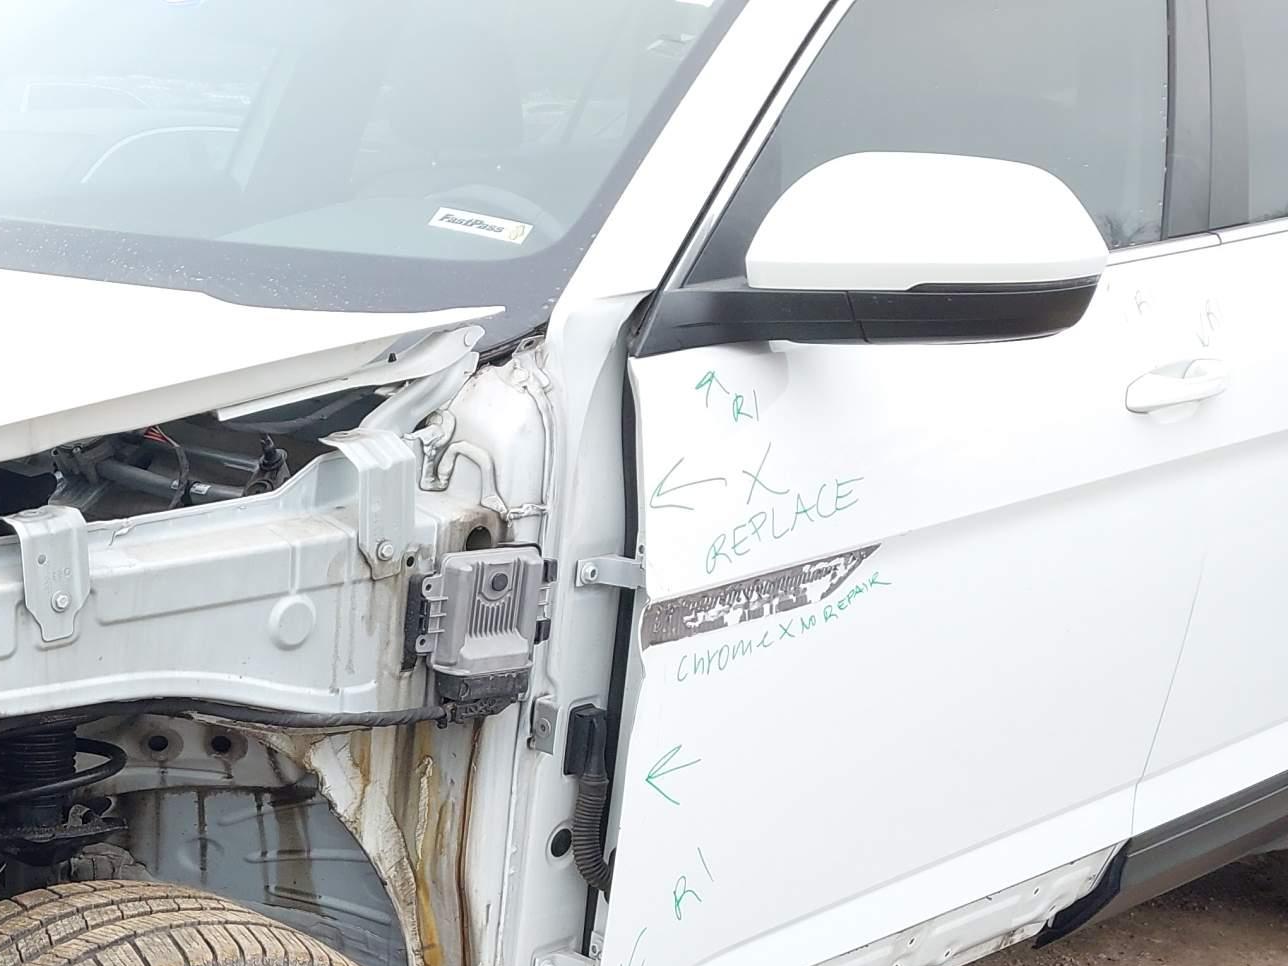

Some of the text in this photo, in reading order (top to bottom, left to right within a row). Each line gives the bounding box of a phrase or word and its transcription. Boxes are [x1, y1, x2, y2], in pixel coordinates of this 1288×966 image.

[438, 213, 505, 233] FastPass
[705, 476, 864, 576] REPLACE
[822, 571, 893, 623] REPAIR
